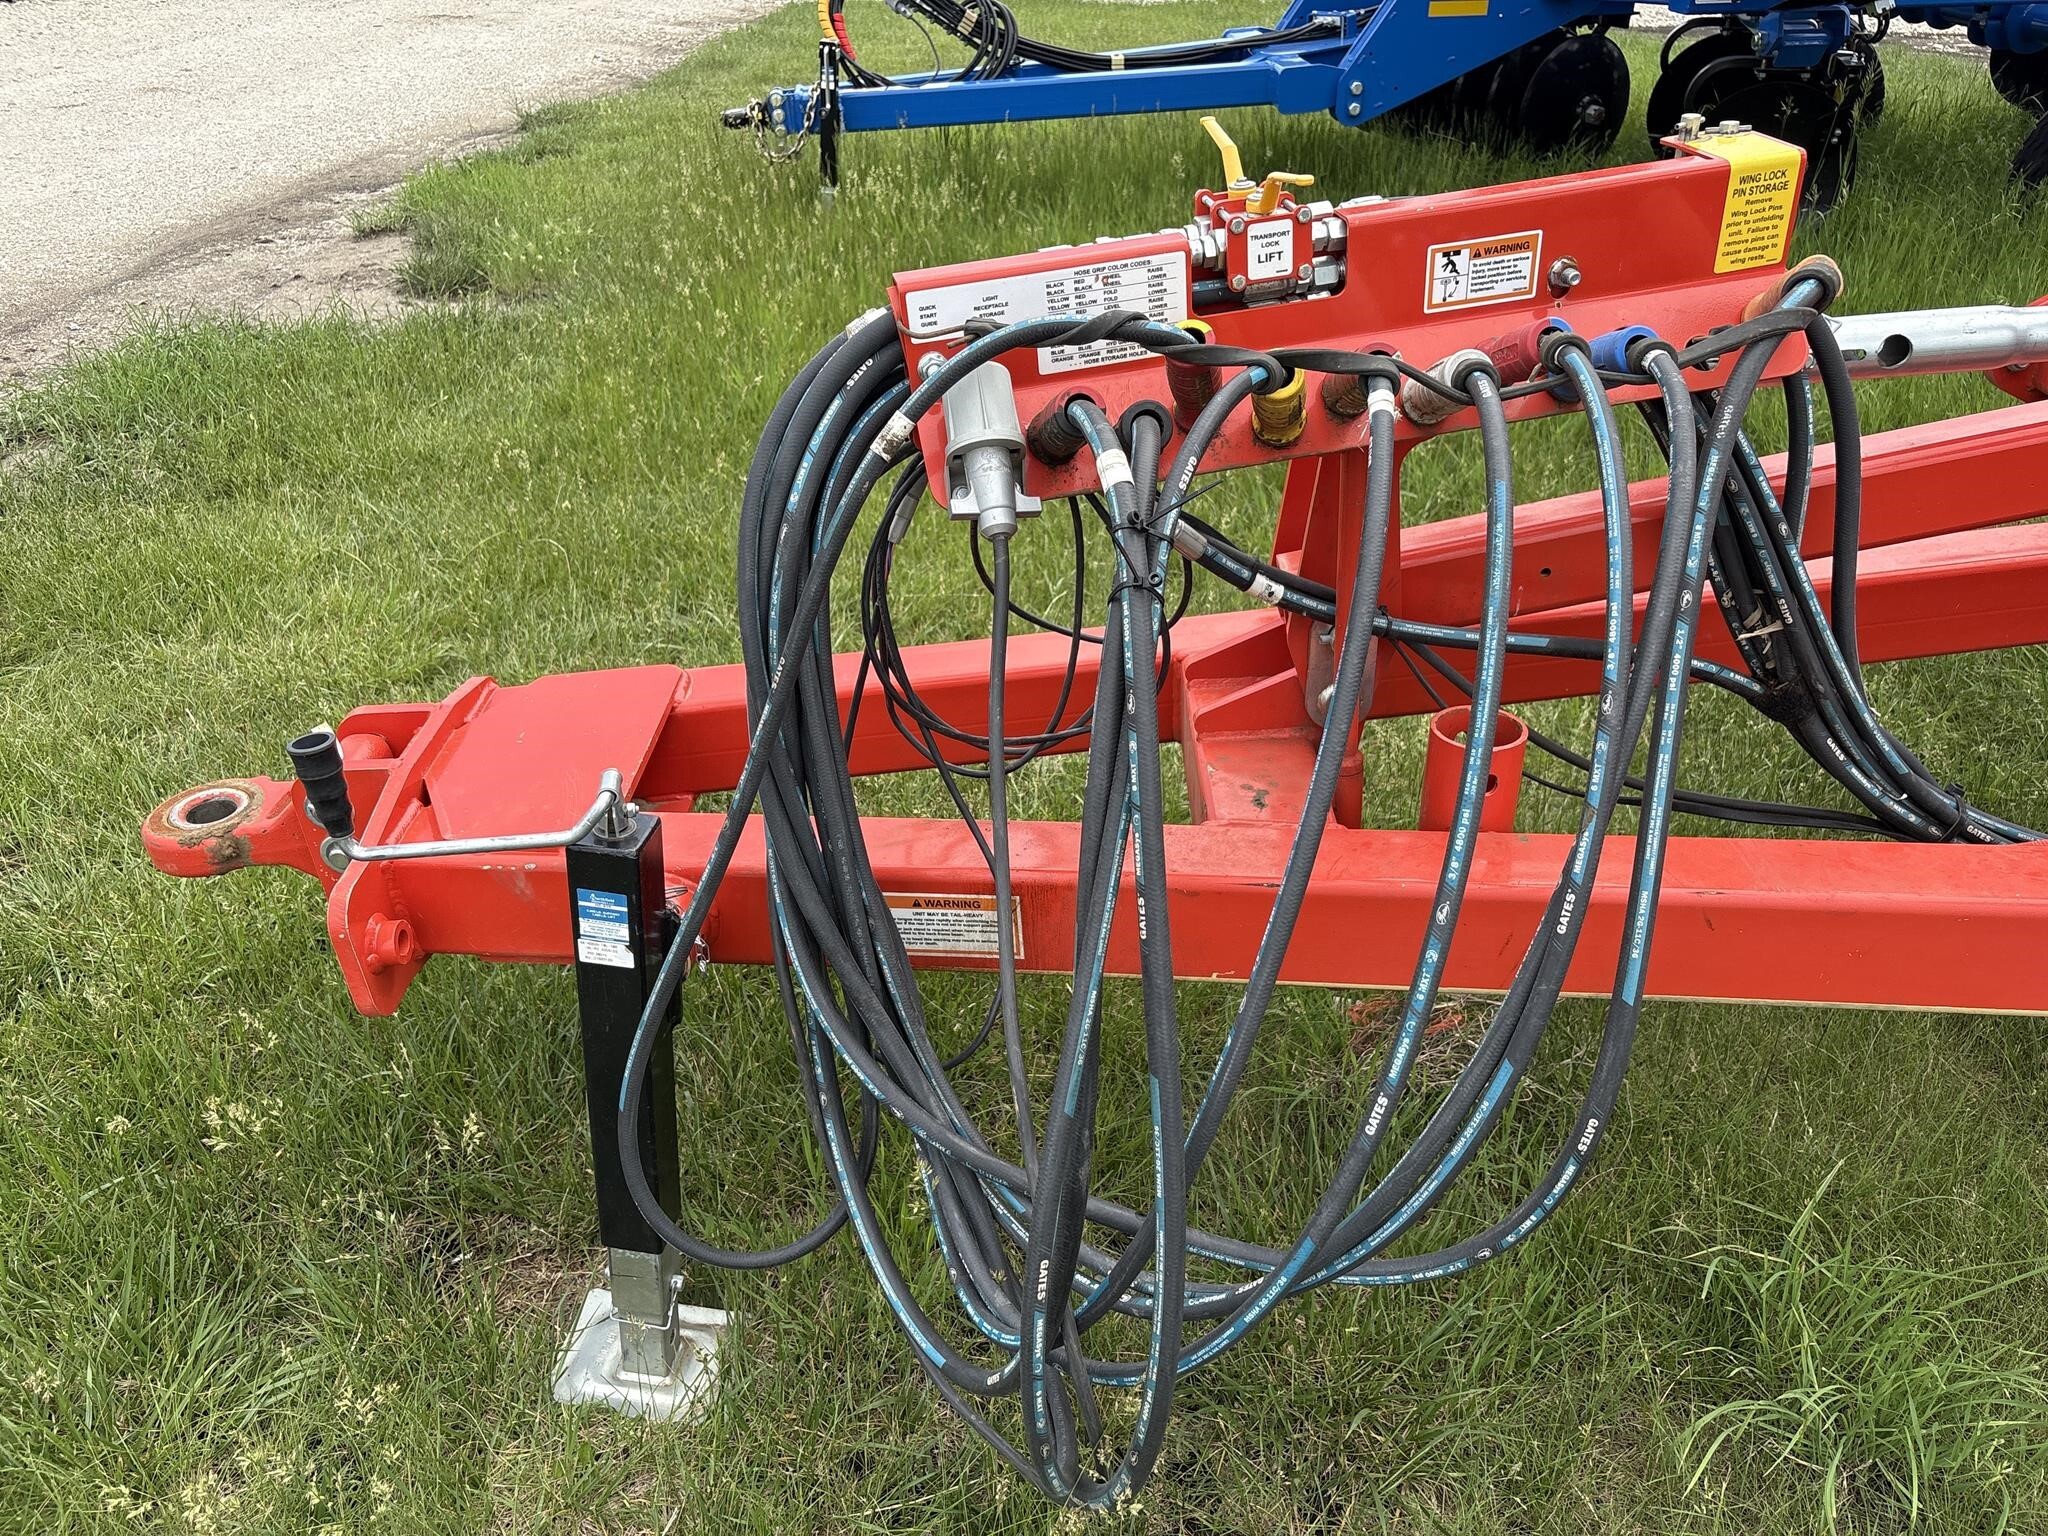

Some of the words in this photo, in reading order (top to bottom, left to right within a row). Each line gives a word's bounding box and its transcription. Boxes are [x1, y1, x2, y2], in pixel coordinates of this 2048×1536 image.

[1739, 173, 1762, 185] WING
[1763, 169, 1788, 181] LOCK
[1732, 188, 1747, 199] PIN
[1748, 180, 1789, 196] STORAGE
[1745, 196, 1773, 206] Remove
[1731, 209, 1748, 218] Wing
[1749, 207, 1767, 215] Lock
[1768, 204, 1783, 212] Pins
[1725, 221, 1743, 230] prior
[1752, 213, 1784, 224] unfolding
[1250, 230, 1291, 241] TRANSPORT
[1728, 229, 1743, 237] unit.
[1746, 225, 1770, 234] Failure
[1261, 240, 1280, 248] LOCK
[1484, 241, 1530, 256] WARNING
[1724, 239, 1749, 247] remove
[1750, 236, 1765, 244] pins
[1258, 250, 1284, 264] LIFT
[1721, 249, 1742, 257] cause
[1743, 244, 1769, 254] damage
[1092, 266, 1106, 274] GRIP
[1107, 263, 1128, 271] COLOR
[1130, 260, 1153, 268] CODES:
[1730, 257, 1747, 265] wing
[1747, 254, 1766, 262] rests.
[1147, 273, 1167, 281] LOWER
[973, 301, 1009, 311] RECEPTACLE
[1047, 303, 1070, 311] YELLOW
[1075, 299, 1097, 307] YELLOW
[1148, 288, 1167, 296] LOWER
[1047, 296, 1069, 304] YELLOW
[979, 310, 1005, 318] STORAGE
[1051, 355, 1074, 363] ORANGE
[1078, 351, 1100, 359] ORANGE
[1101, 354, 1128, 362] STORAGE
[847, 357, 874, 388] GATES
[1179, 456, 1197, 491] GATES
[1762, 480, 1770, 497] MXT
[1302, 597, 1317, 608] 4000
[1318, 603, 1327, 611] psi
[1609, 620, 1617, 643] 4800
[1672, 652, 1683, 677] 4000
[771, 657, 786, 690] GATES
[1735, 674, 1748, 684] MXT
[1669, 677, 1677, 691] psi
[1826, 738, 1846, 761] GATES
[1574, 831, 1589, 874] MEGASys
[1593, 763, 1603, 783] MXT
[1455, 826, 1466, 852] 4800
[1462, 809, 1471, 826] psi
[1967, 825, 1992, 842] GATES
[1134, 834, 1142, 876] MEGASys
[925, 899, 981, 909] WARNING
[1138, 896, 1147, 939] GATES
[1557, 892, 1576, 935] GATES
[1389, 1038, 1410, 1079] MEGASys
[1419, 970, 1430, 992] MXT
[1365, 1099, 1388, 1135] GATES
[1577, 1118, 1598, 1152] GATES
[1450, 1138, 1467, 1158] MSHA
[1553, 1165, 1575, 1194] MEGASys
[1517, 1219, 1533, 1234] MXT
[1039, 1260, 1049, 1301] GATES
[1412, 1272, 1424, 1280] psi
[1425, 1269, 1443, 1278] 4000
[1243, 1307, 1259, 1324] MSHA
